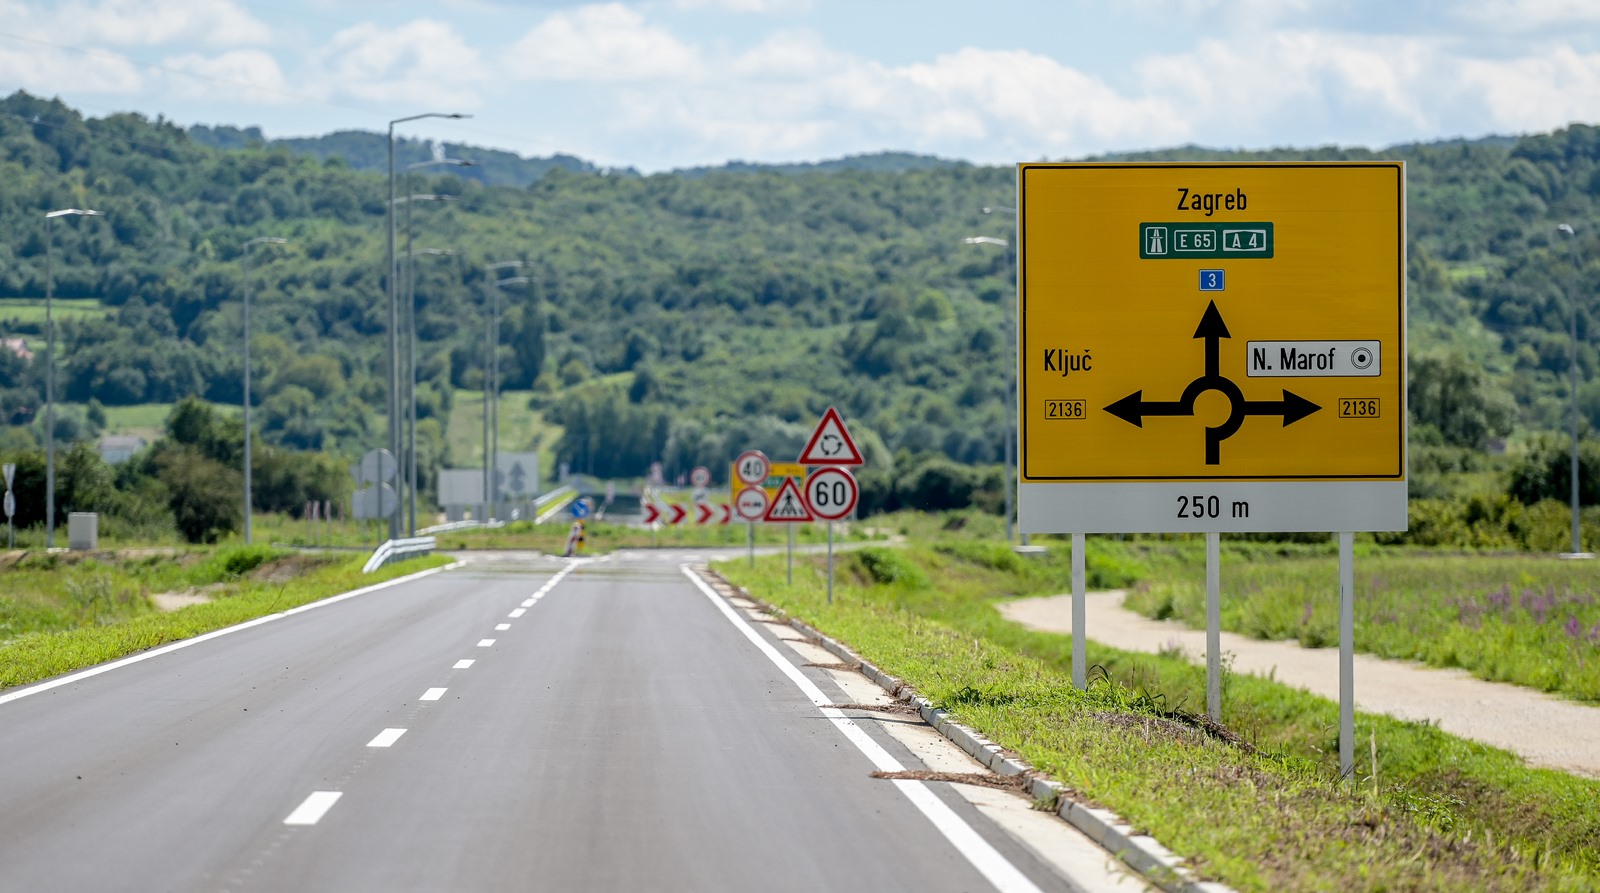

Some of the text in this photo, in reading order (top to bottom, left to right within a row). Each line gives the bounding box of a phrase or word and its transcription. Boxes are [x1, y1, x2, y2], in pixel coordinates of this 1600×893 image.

[1177, 188, 1247, 216] Zagreb
[1180, 234, 1211, 248] E 65
[1232, 234, 1257, 247] A 4
[1208, 274, 1216, 288] 3
[1044, 349, 1092, 376] Ključ
[1254, 348, 1335, 370] N. Marof
[1049, 402, 1082, 416] 2136
[1343, 401, 1376, 415] 2136
[743, 462, 762, 476] 40
[816, 481, 846, 506] 60
[1177, 496, 1249, 518] 250 m
